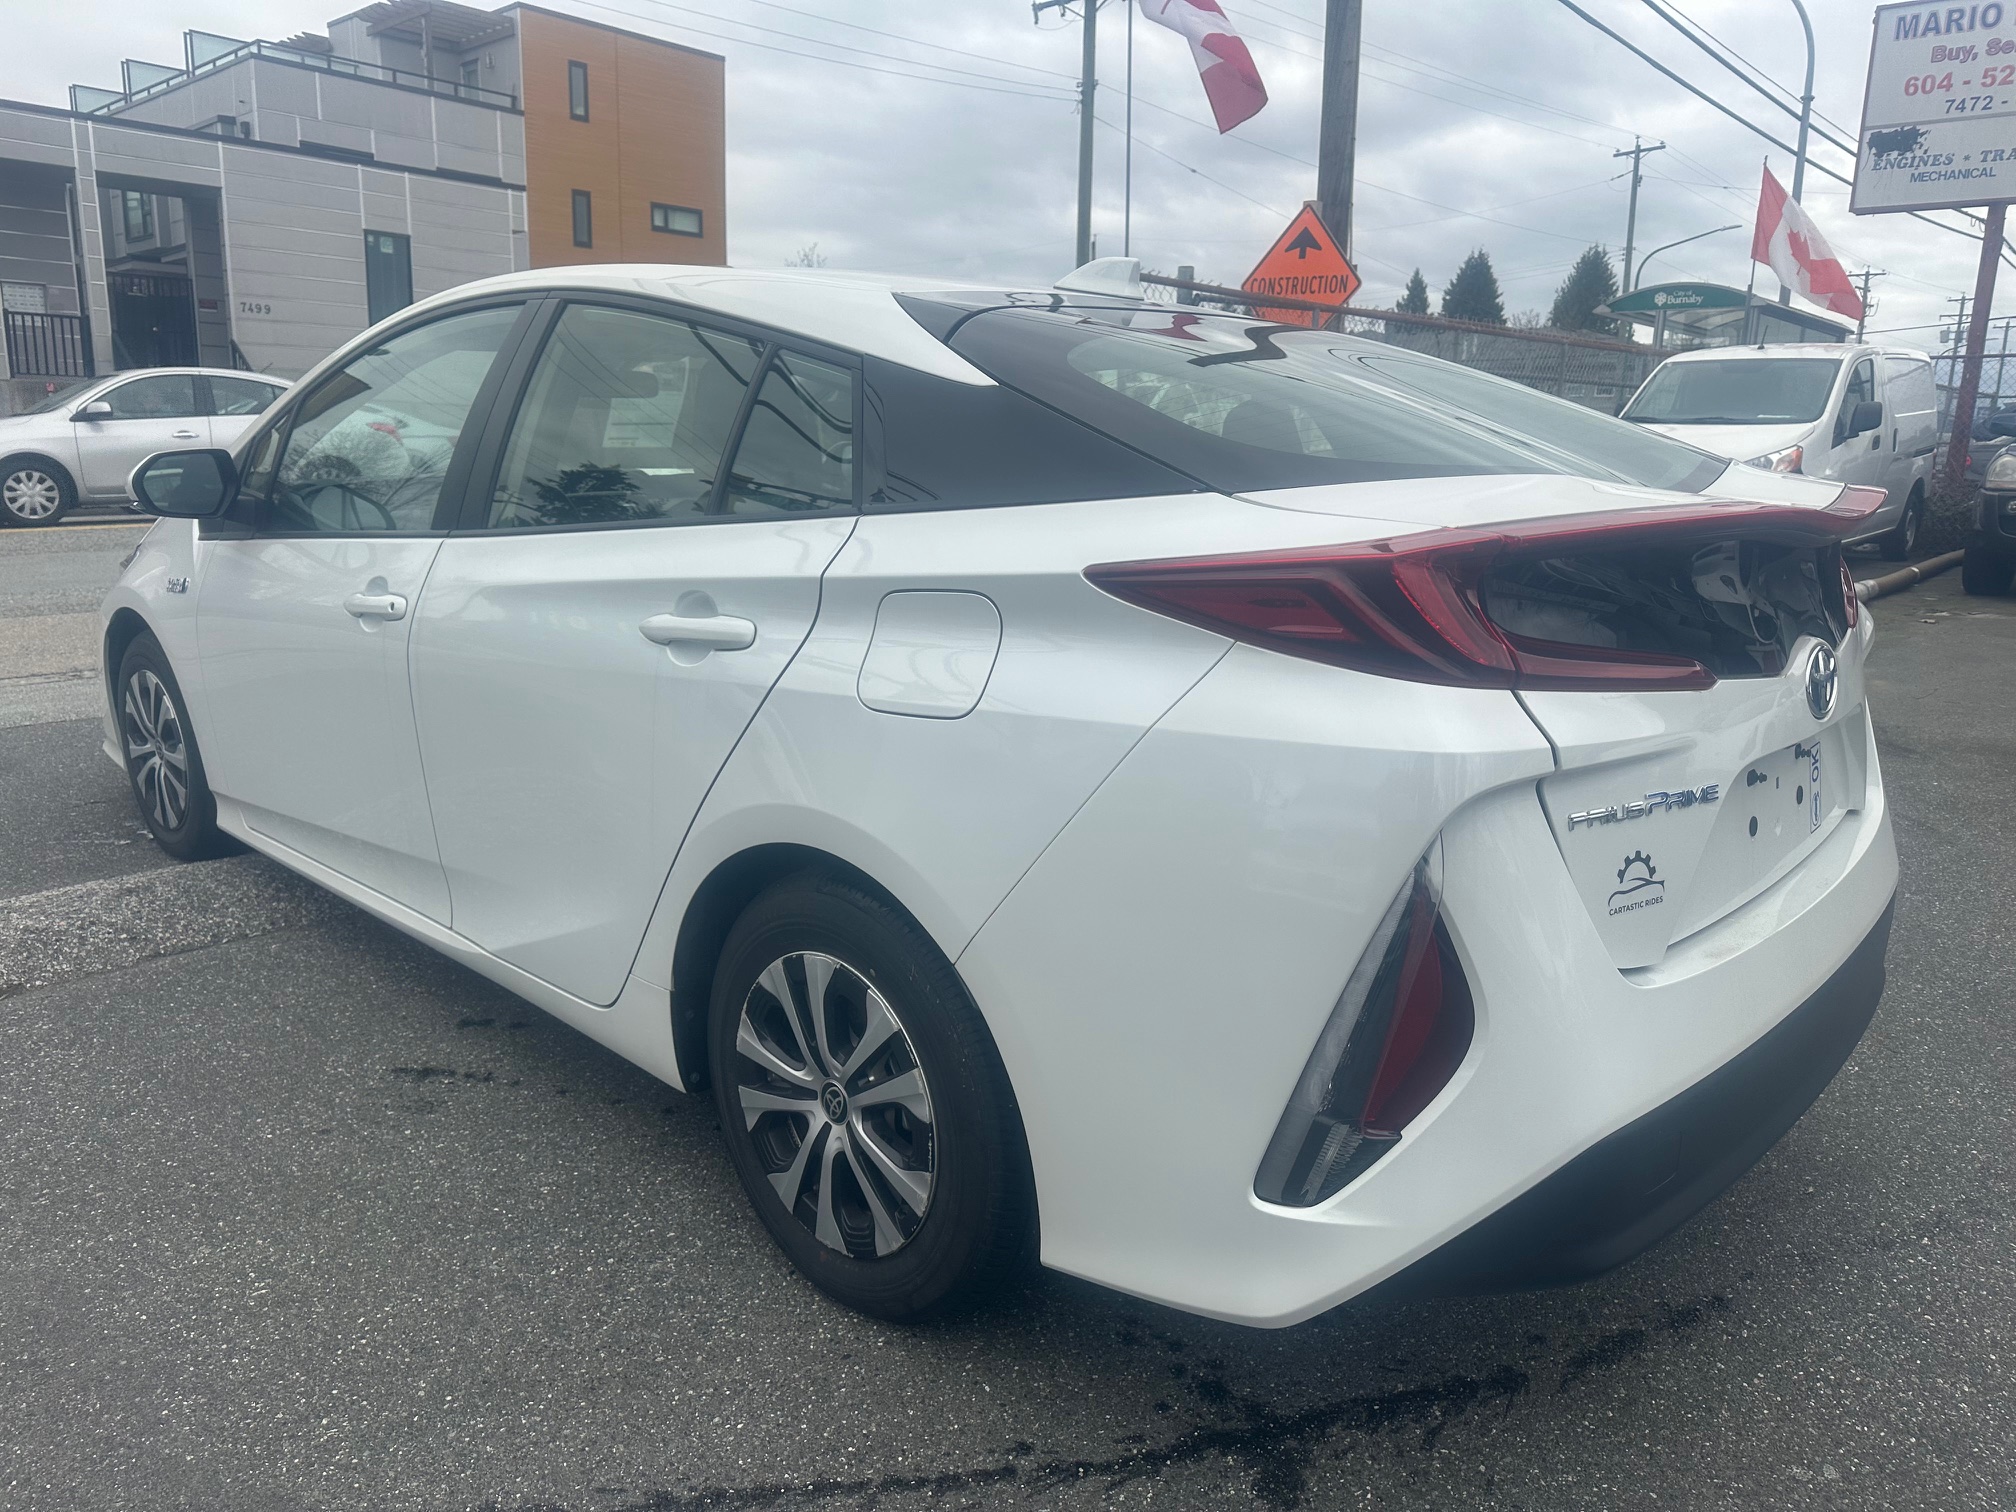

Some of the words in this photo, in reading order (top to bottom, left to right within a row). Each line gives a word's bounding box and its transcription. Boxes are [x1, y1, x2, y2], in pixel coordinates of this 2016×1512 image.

[1895, 3, 2003, 41] MARIO
[1930, 43, 1979, 63] Buy,
[1904, 72, 1953, 96] 604
[1945, 95, 1994, 114] 7472
[1871, 152, 1955, 171] ENGINES
[1909, 166, 1997, 183] MECHANICAL
[1250, 274, 1349, 295] CONSTRUCTION
[239, 301, 272, 315] 7499
[1667, 294, 1704, 305] Burnaby
[1811, 747, 1820, 783] OK
[1608, 900, 1644, 916] CARTASTIC
[1645, 895, 1664, 907] RIDES
